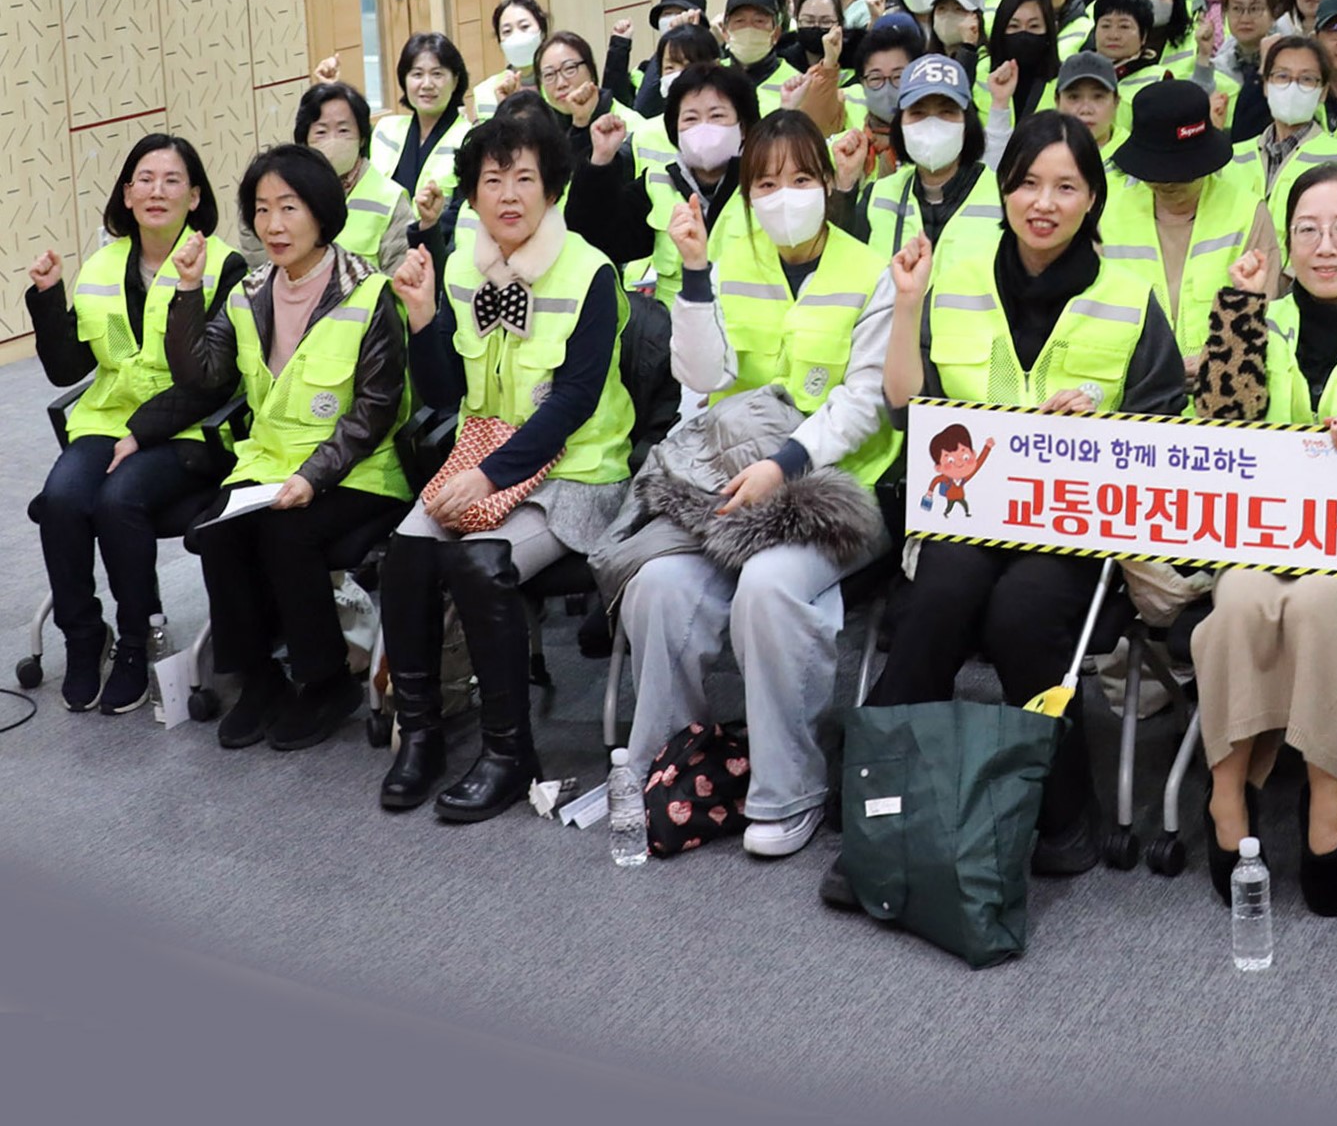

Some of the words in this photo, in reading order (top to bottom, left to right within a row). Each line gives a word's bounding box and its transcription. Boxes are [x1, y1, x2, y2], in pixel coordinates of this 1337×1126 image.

[925, 62, 959, 86] 53
[1010, 434, 1101, 463] 어린이와
[1111, 439, 1156, 469] 함께
[1168, 445, 1257, 479] 하교하는
